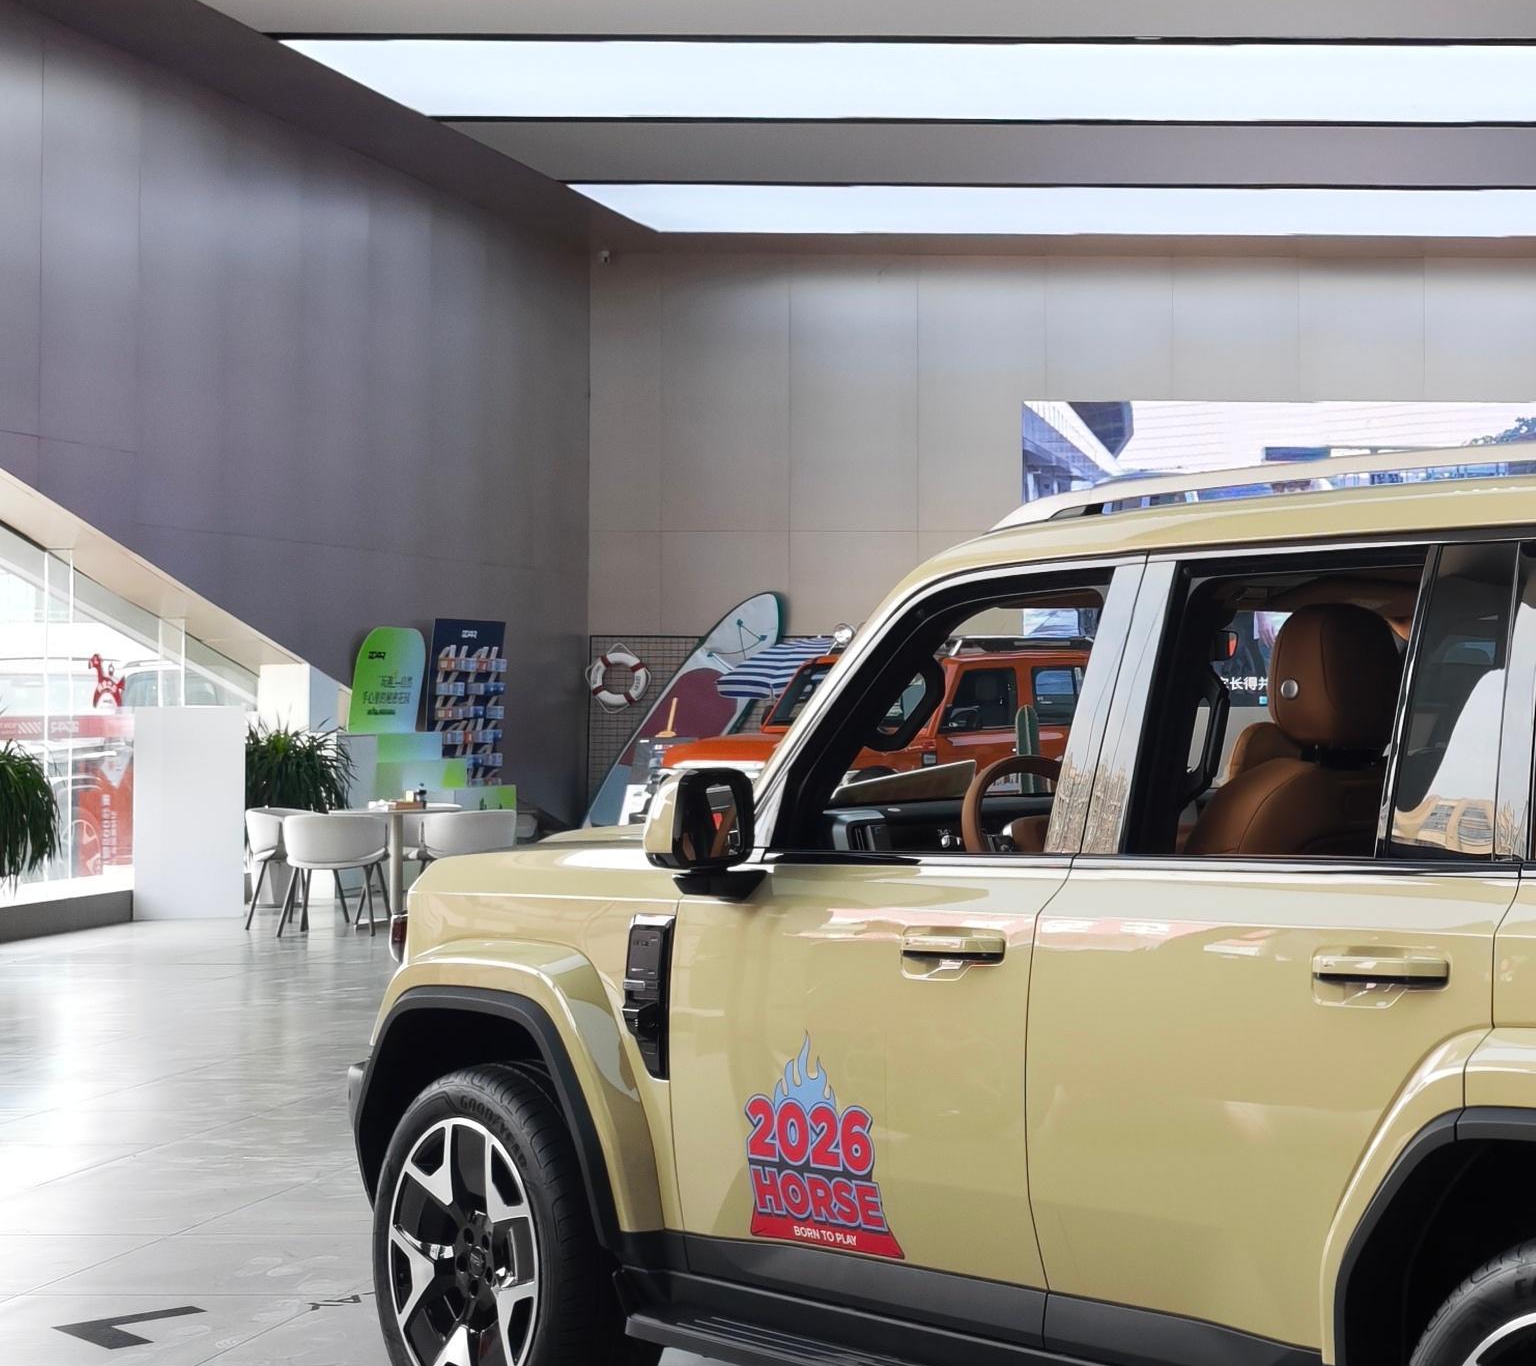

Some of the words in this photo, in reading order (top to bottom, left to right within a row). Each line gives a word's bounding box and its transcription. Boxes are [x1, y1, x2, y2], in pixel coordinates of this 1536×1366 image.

[745, 1093, 875, 1176] 2026
[751, 1164, 888, 1232] HORSE
[793, 1225, 820, 1241] BORN
[819, 1231, 835, 1242] TO
[836, 1232, 857, 1246] PLAY
